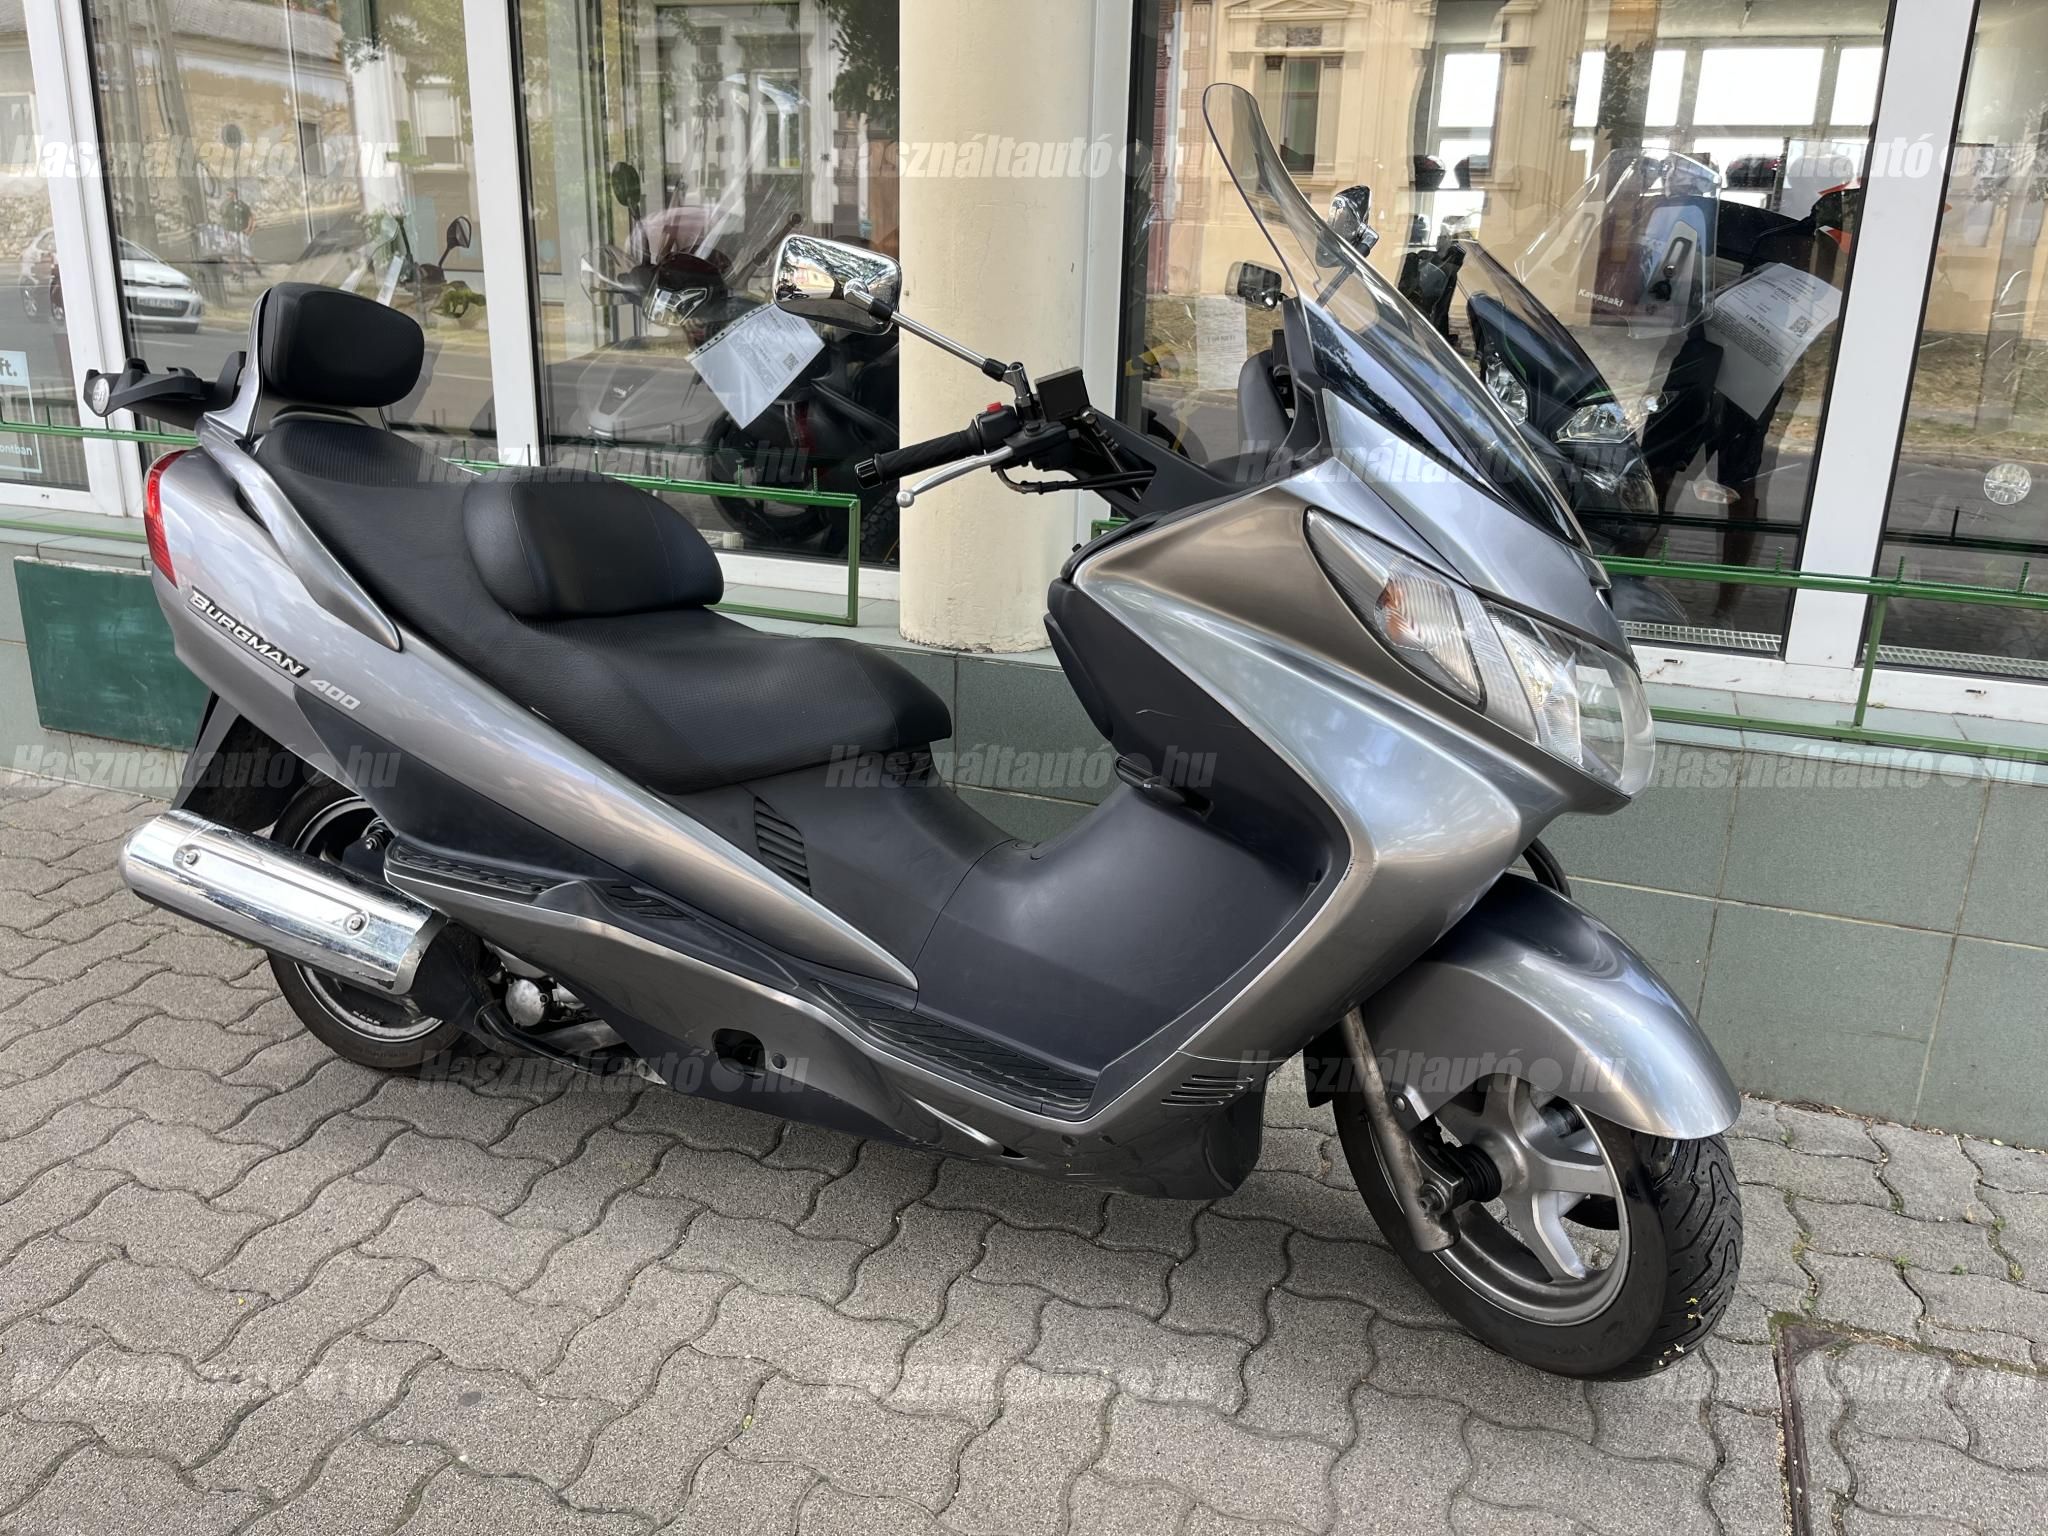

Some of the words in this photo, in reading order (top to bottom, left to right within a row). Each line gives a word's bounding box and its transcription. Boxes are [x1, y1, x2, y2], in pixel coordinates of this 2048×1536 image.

[1577, 288, 1624, 308] Kawasaki
[189, 590, 304, 676] BURGMAN
[310, 679, 361, 711] 400
